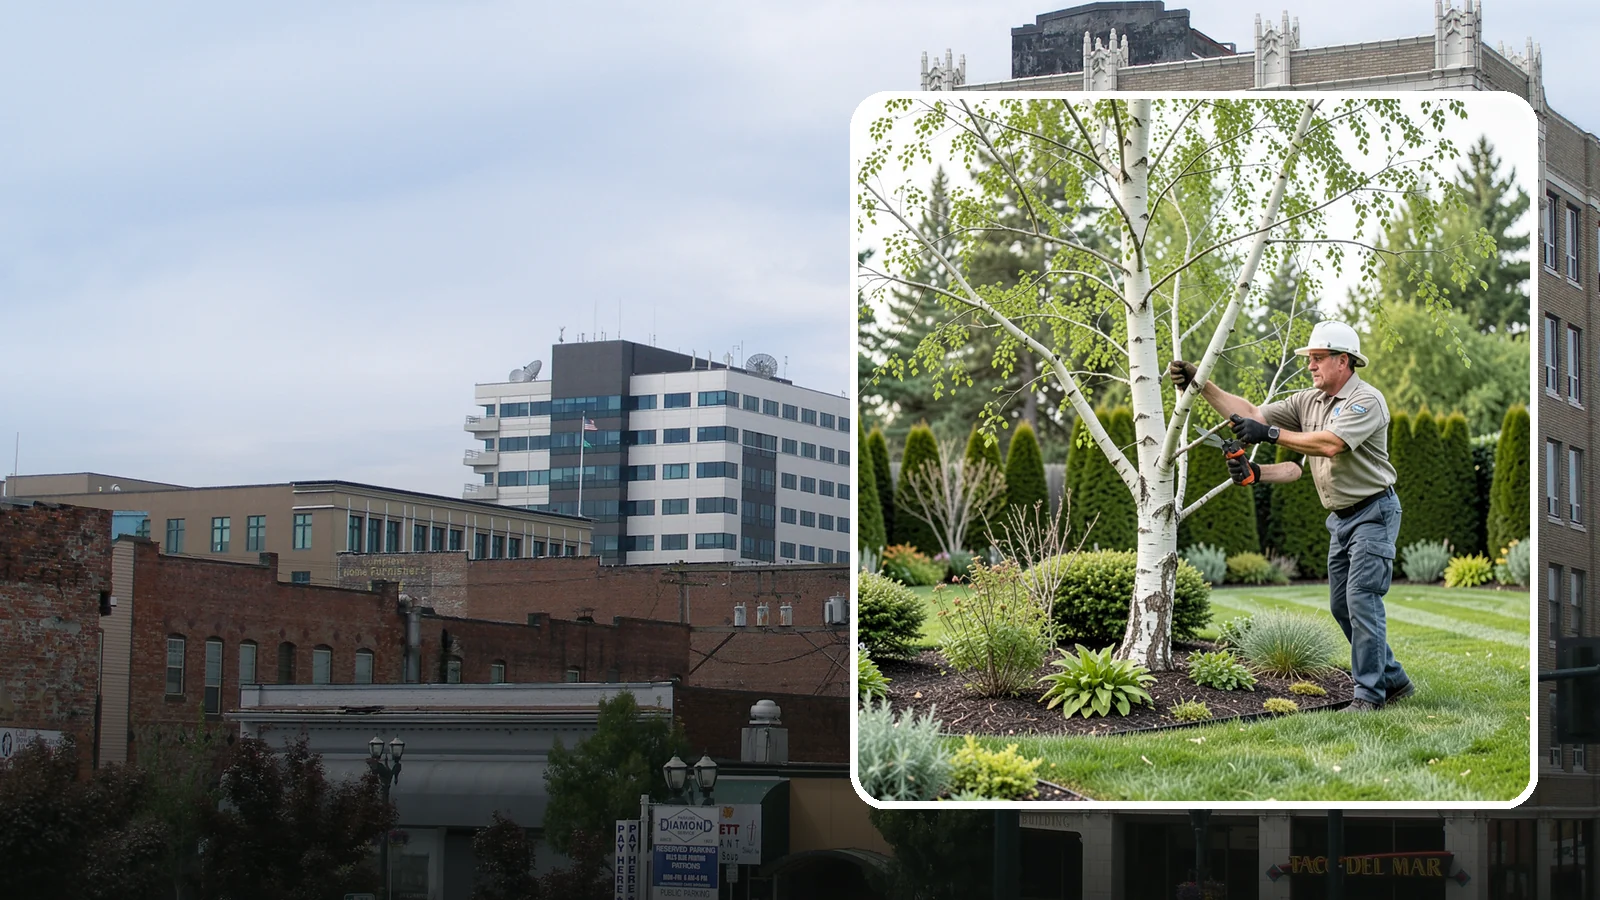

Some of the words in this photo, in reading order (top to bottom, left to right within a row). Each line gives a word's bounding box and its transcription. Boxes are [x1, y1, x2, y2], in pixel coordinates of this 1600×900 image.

[661, 818, 713, 833] DIAMOND
[1022, 815, 1070, 827] BUILDING
[720, 824, 740, 835] ETT
[629, 825, 637, 852] PAY
[722, 851, 738, 862] Soup
[672, 862, 701, 870] PATRONS
[1289, 855, 1330, 874] TAC
[1346, 856, 1384, 876] DEL
[1392, 857, 1443, 877] MAR
[617, 856, 625, 893] HERE
[628, 856, 636, 893] HERE
[661, 889, 682, 897] PUBLIC
[684, 890, 710, 898] PARKING
